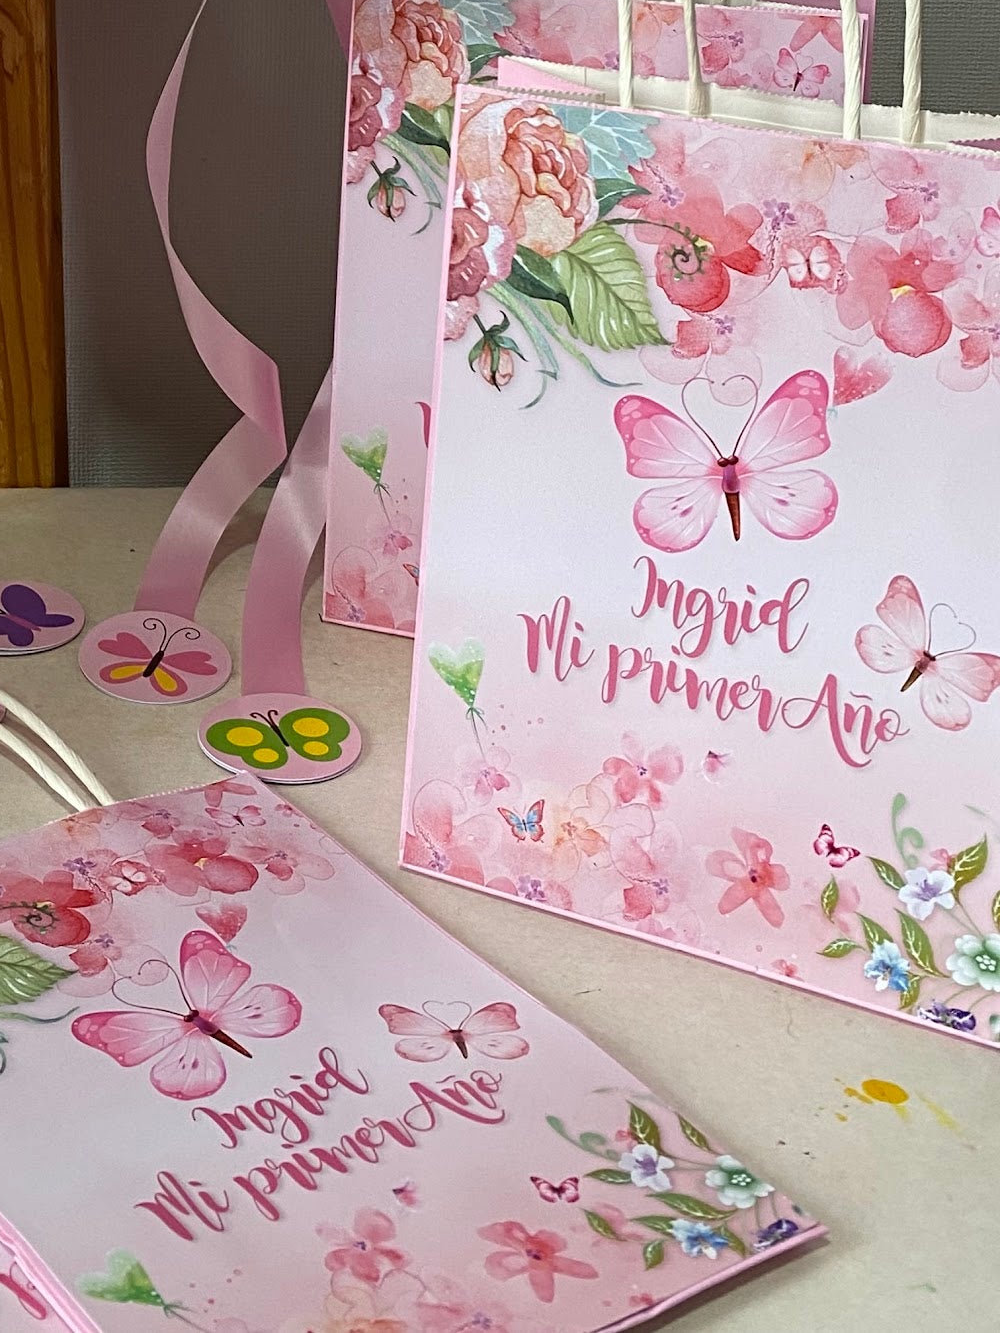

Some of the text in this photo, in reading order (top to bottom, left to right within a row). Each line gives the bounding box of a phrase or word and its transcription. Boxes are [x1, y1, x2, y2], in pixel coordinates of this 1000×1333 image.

[631, 555, 810, 659] Ingrid
[517, 595, 910, 768] Mi primer Año
[134, 1070, 505, 1242] Mi primer Año
[191, 1046, 369, 1144] Ingrid
